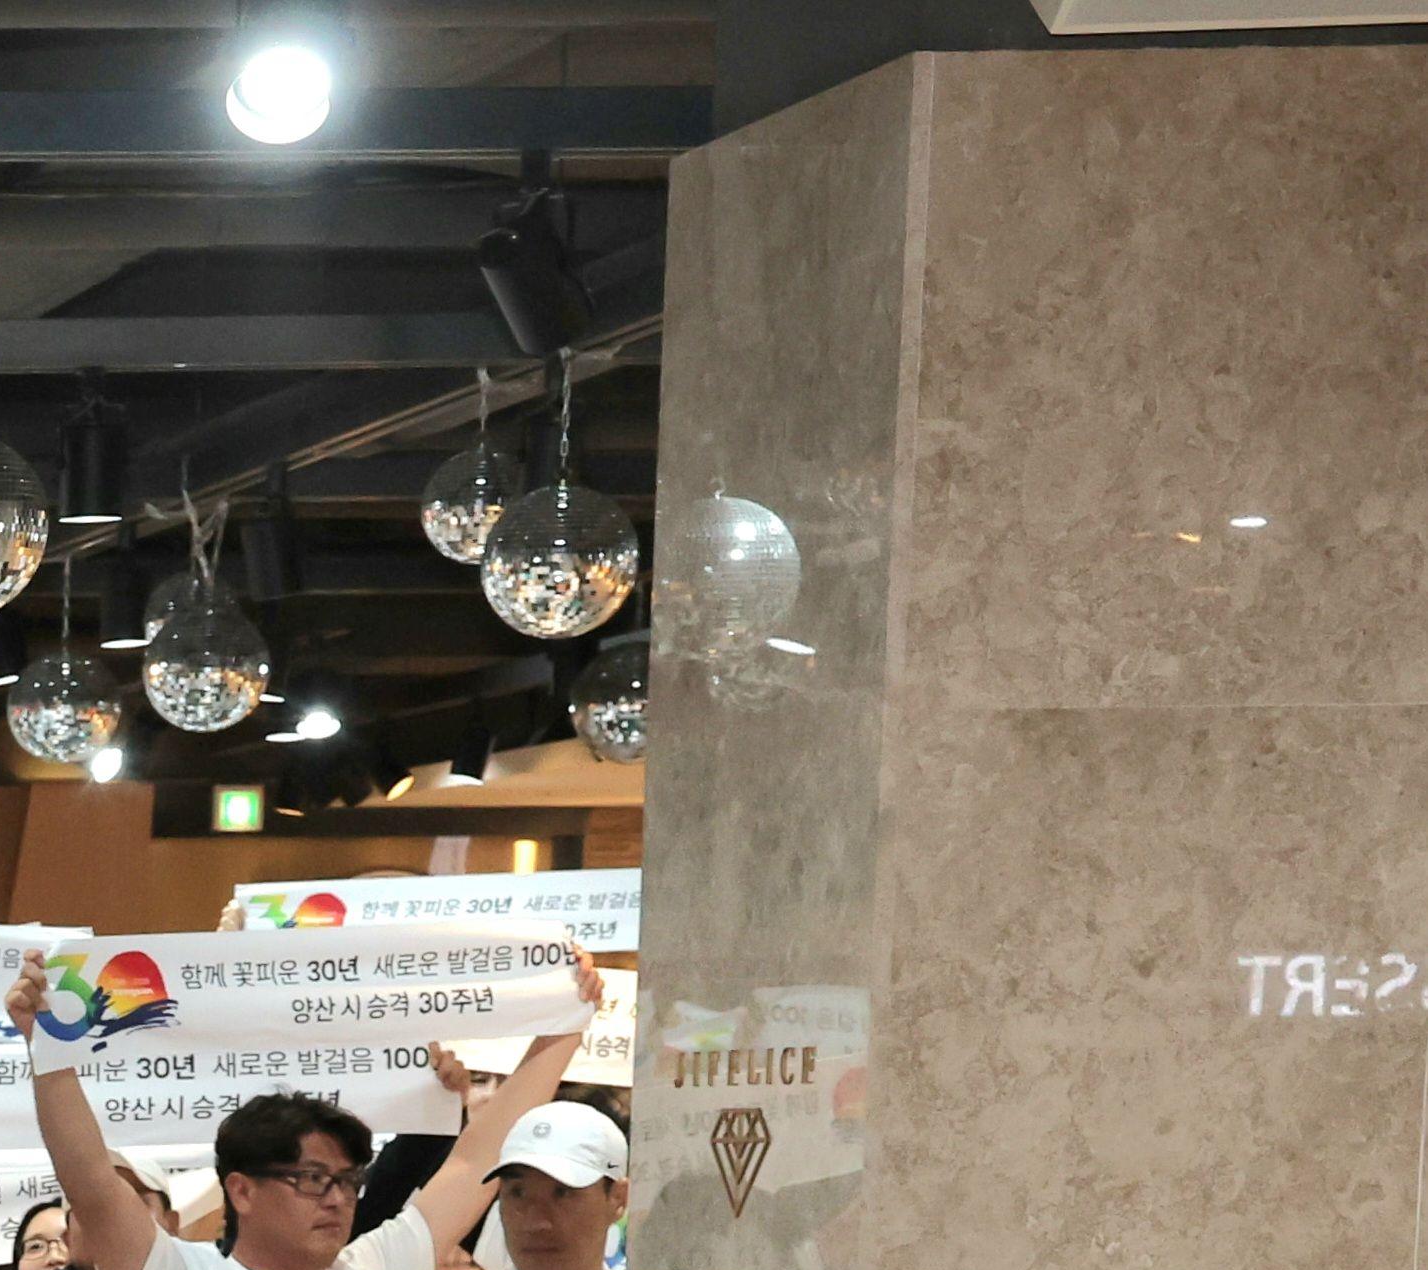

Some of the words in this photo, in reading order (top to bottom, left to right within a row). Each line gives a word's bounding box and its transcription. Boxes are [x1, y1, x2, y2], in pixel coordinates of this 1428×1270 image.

[181, 963, 227, 989] 함께
[232, 960, 298, 987] 꽃피운
[307, 956, 359, 982] 30년
[374, 951, 438, 978] 새로운
[447, 946, 513, 974] 발걸음
